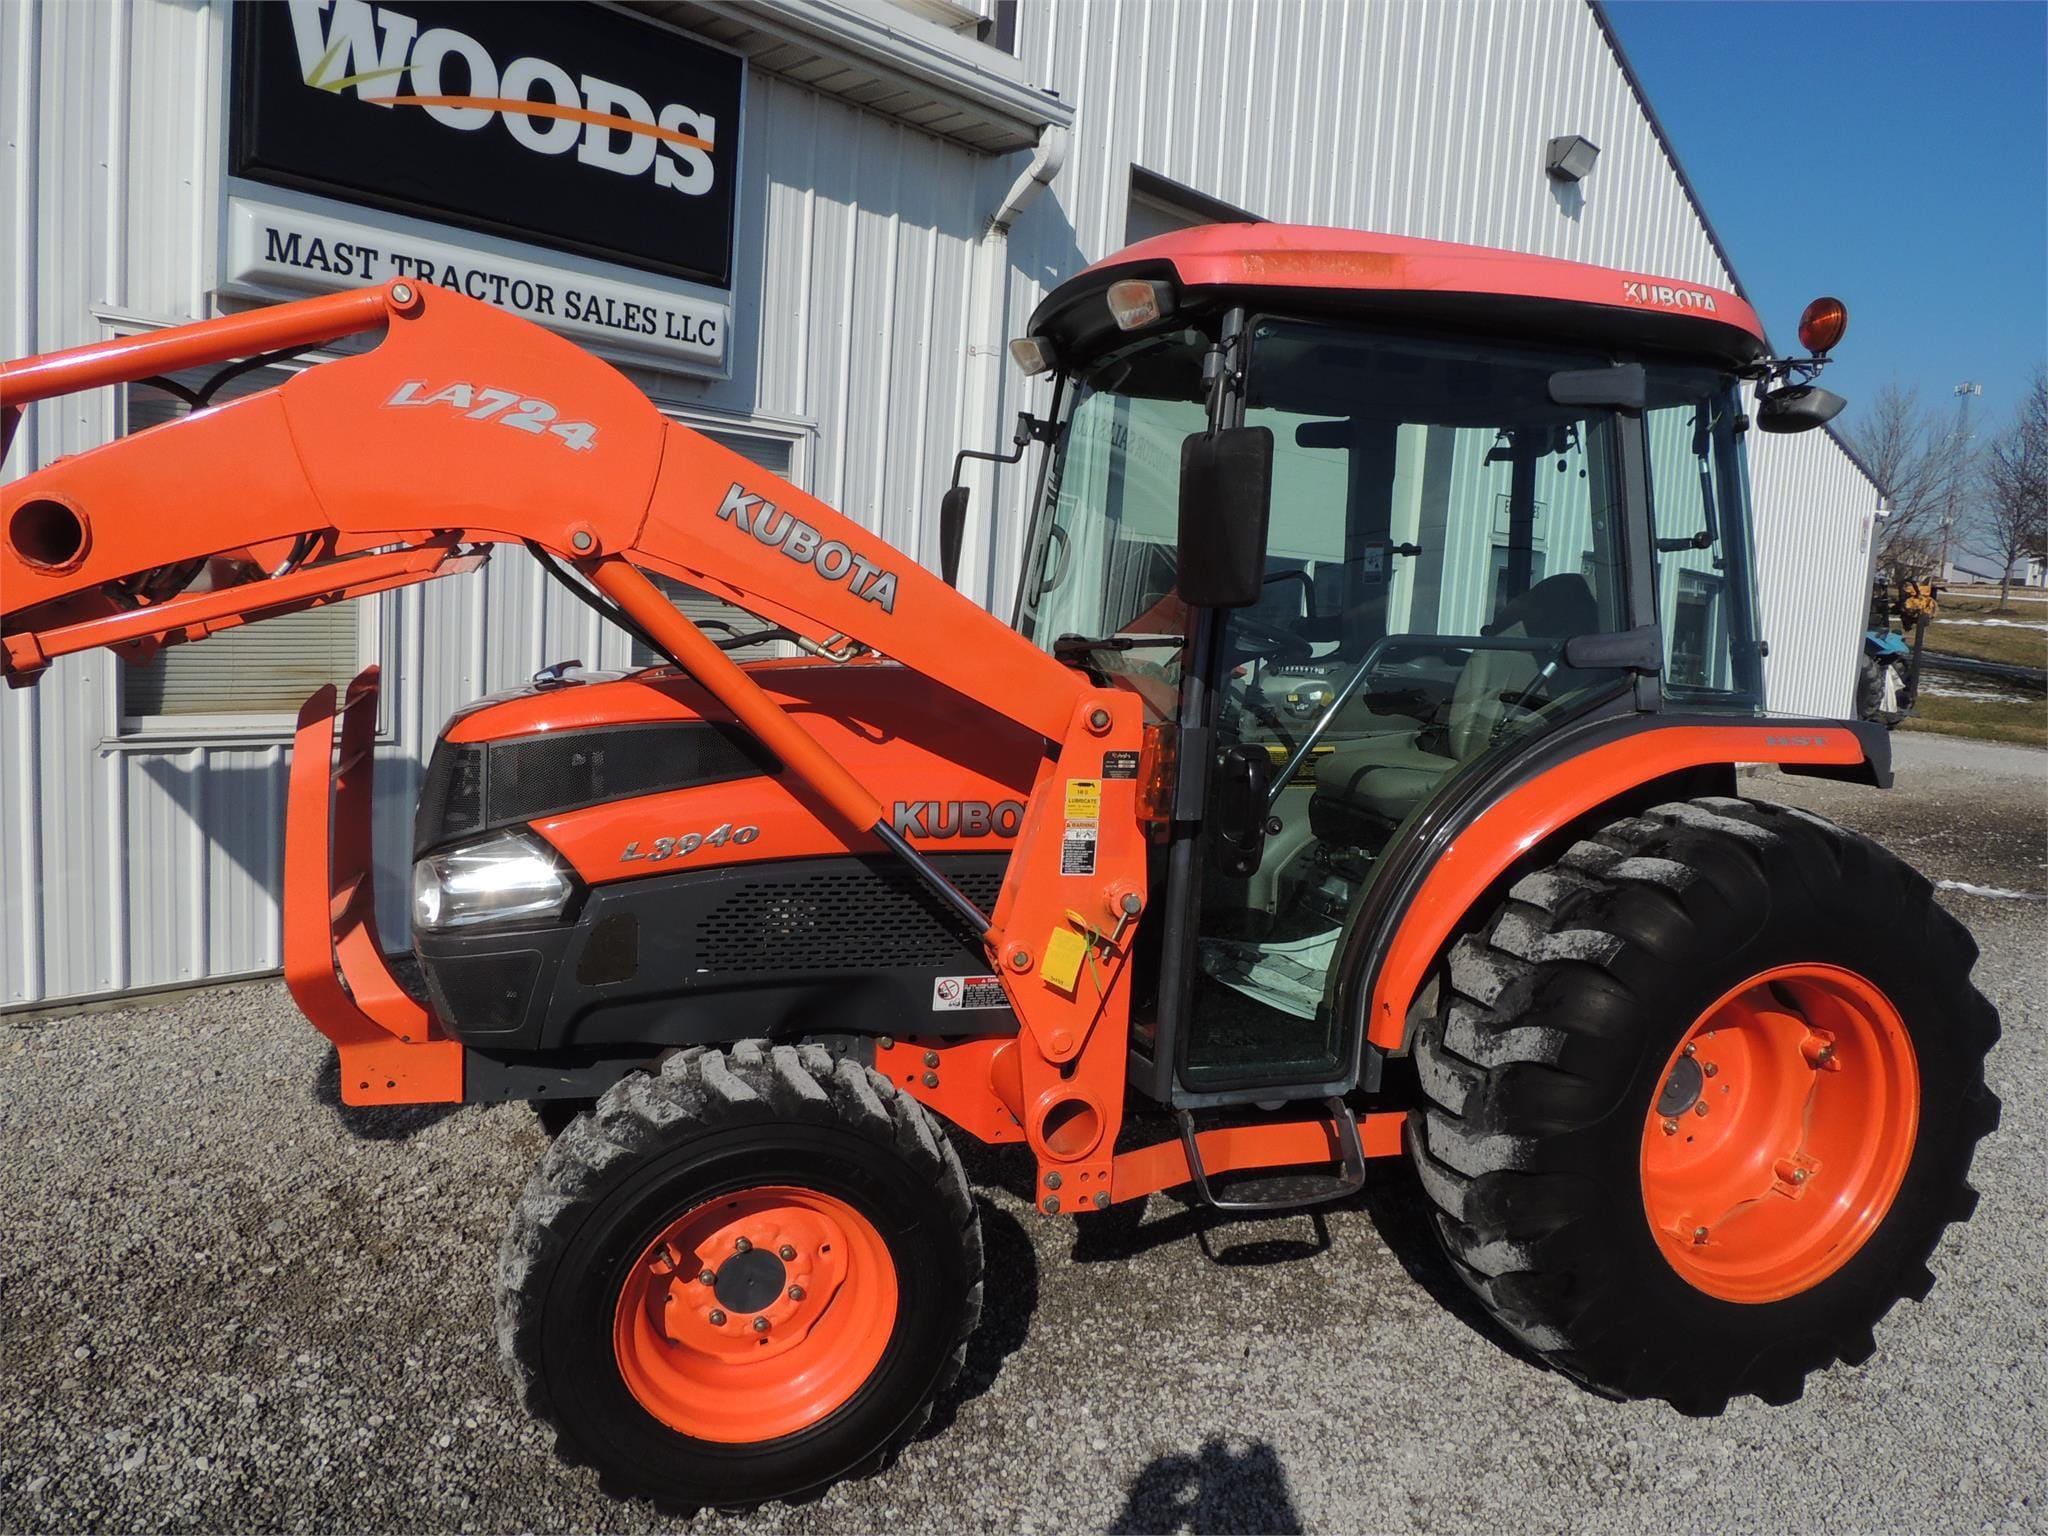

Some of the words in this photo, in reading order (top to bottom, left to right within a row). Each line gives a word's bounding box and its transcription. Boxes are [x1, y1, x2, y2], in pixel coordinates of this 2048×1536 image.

[287, 0, 716, 196] WOODS
[265, 227, 379, 280] MAST
[390, 253, 555, 316] TRACTOR
[564, 289, 657, 336] SALES
[664, 310, 717, 347] LLC
[1622, 280, 1718, 313] KUBOTA
[382, 379, 600, 453] LA724
[715, 481, 899, 616] KUBOTA
[618, 823, 761, 863] L3940
[893, 800, 1028, 840] KUBO
